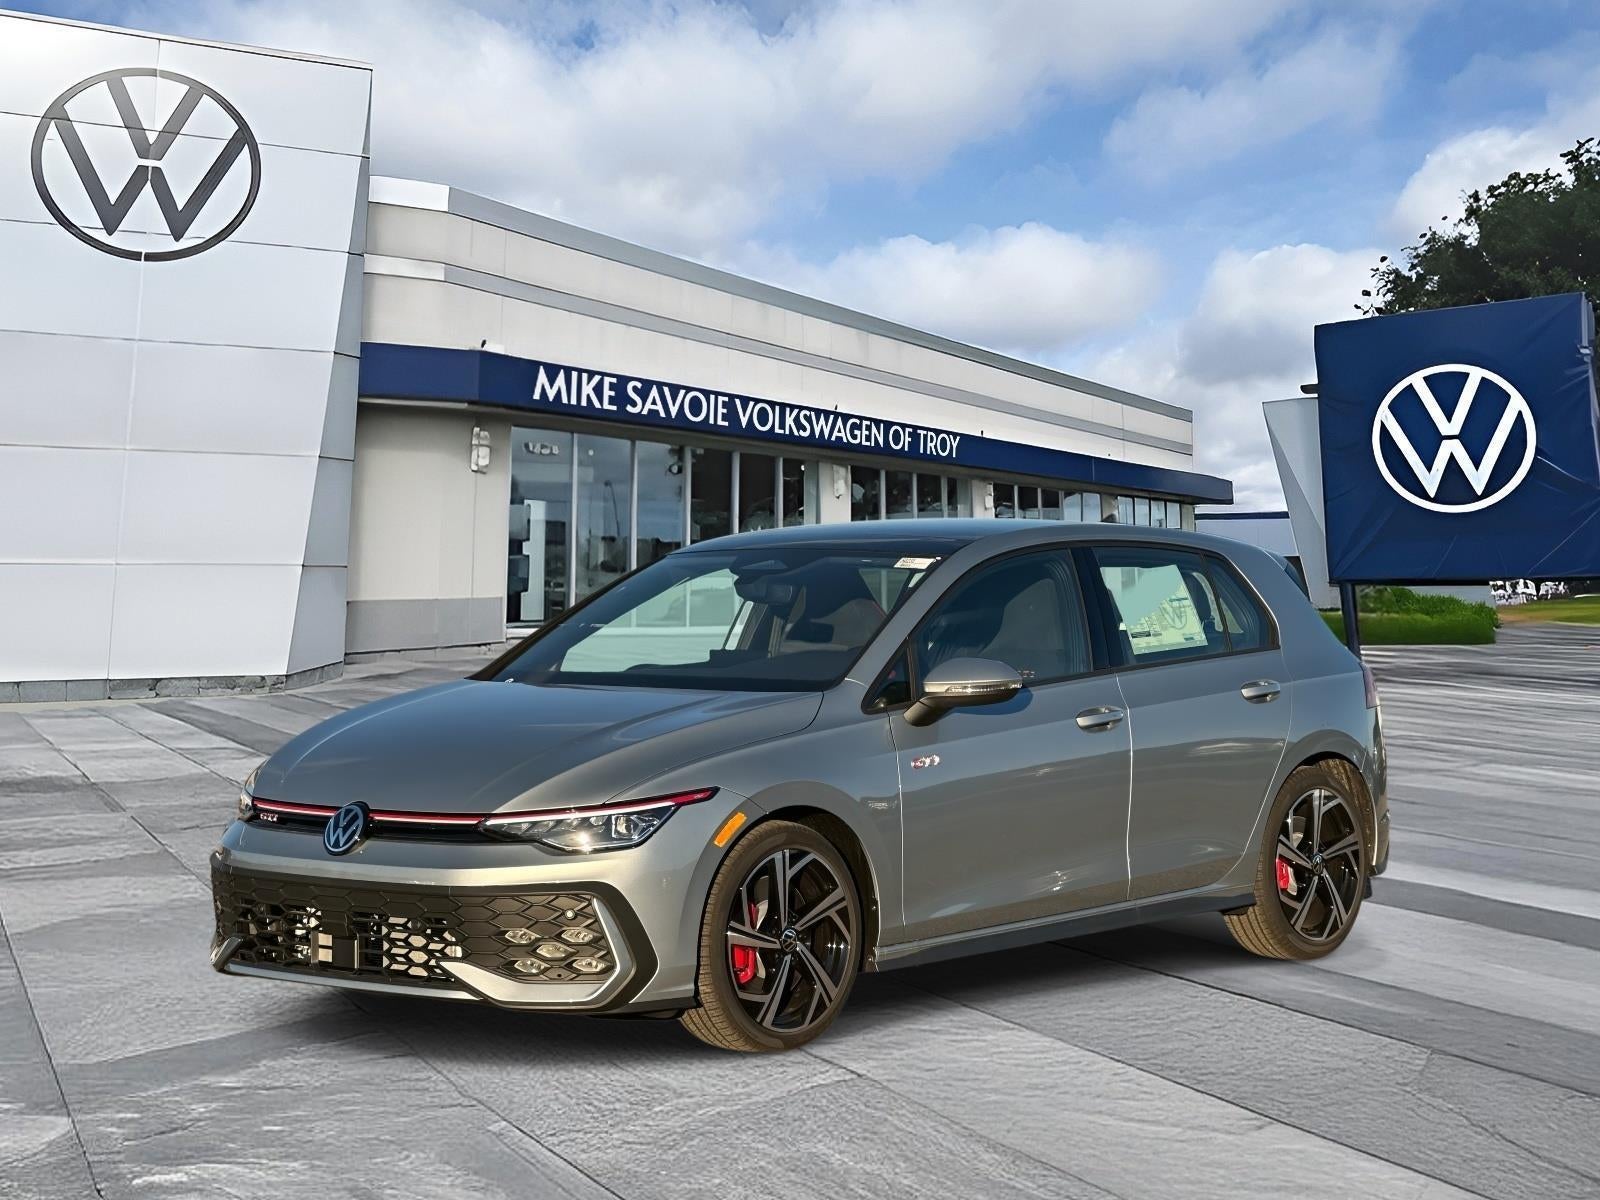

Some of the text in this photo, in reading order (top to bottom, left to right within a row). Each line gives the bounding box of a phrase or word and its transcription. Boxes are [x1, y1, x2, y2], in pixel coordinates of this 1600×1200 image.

[44, 70, 253, 246] VW
[533, 366, 960, 458] MIKE SAVOIE VOLKSWAGEN OF TROY
[1376, 367, 1529, 503] VW
[326, 805, 363, 848] VW
